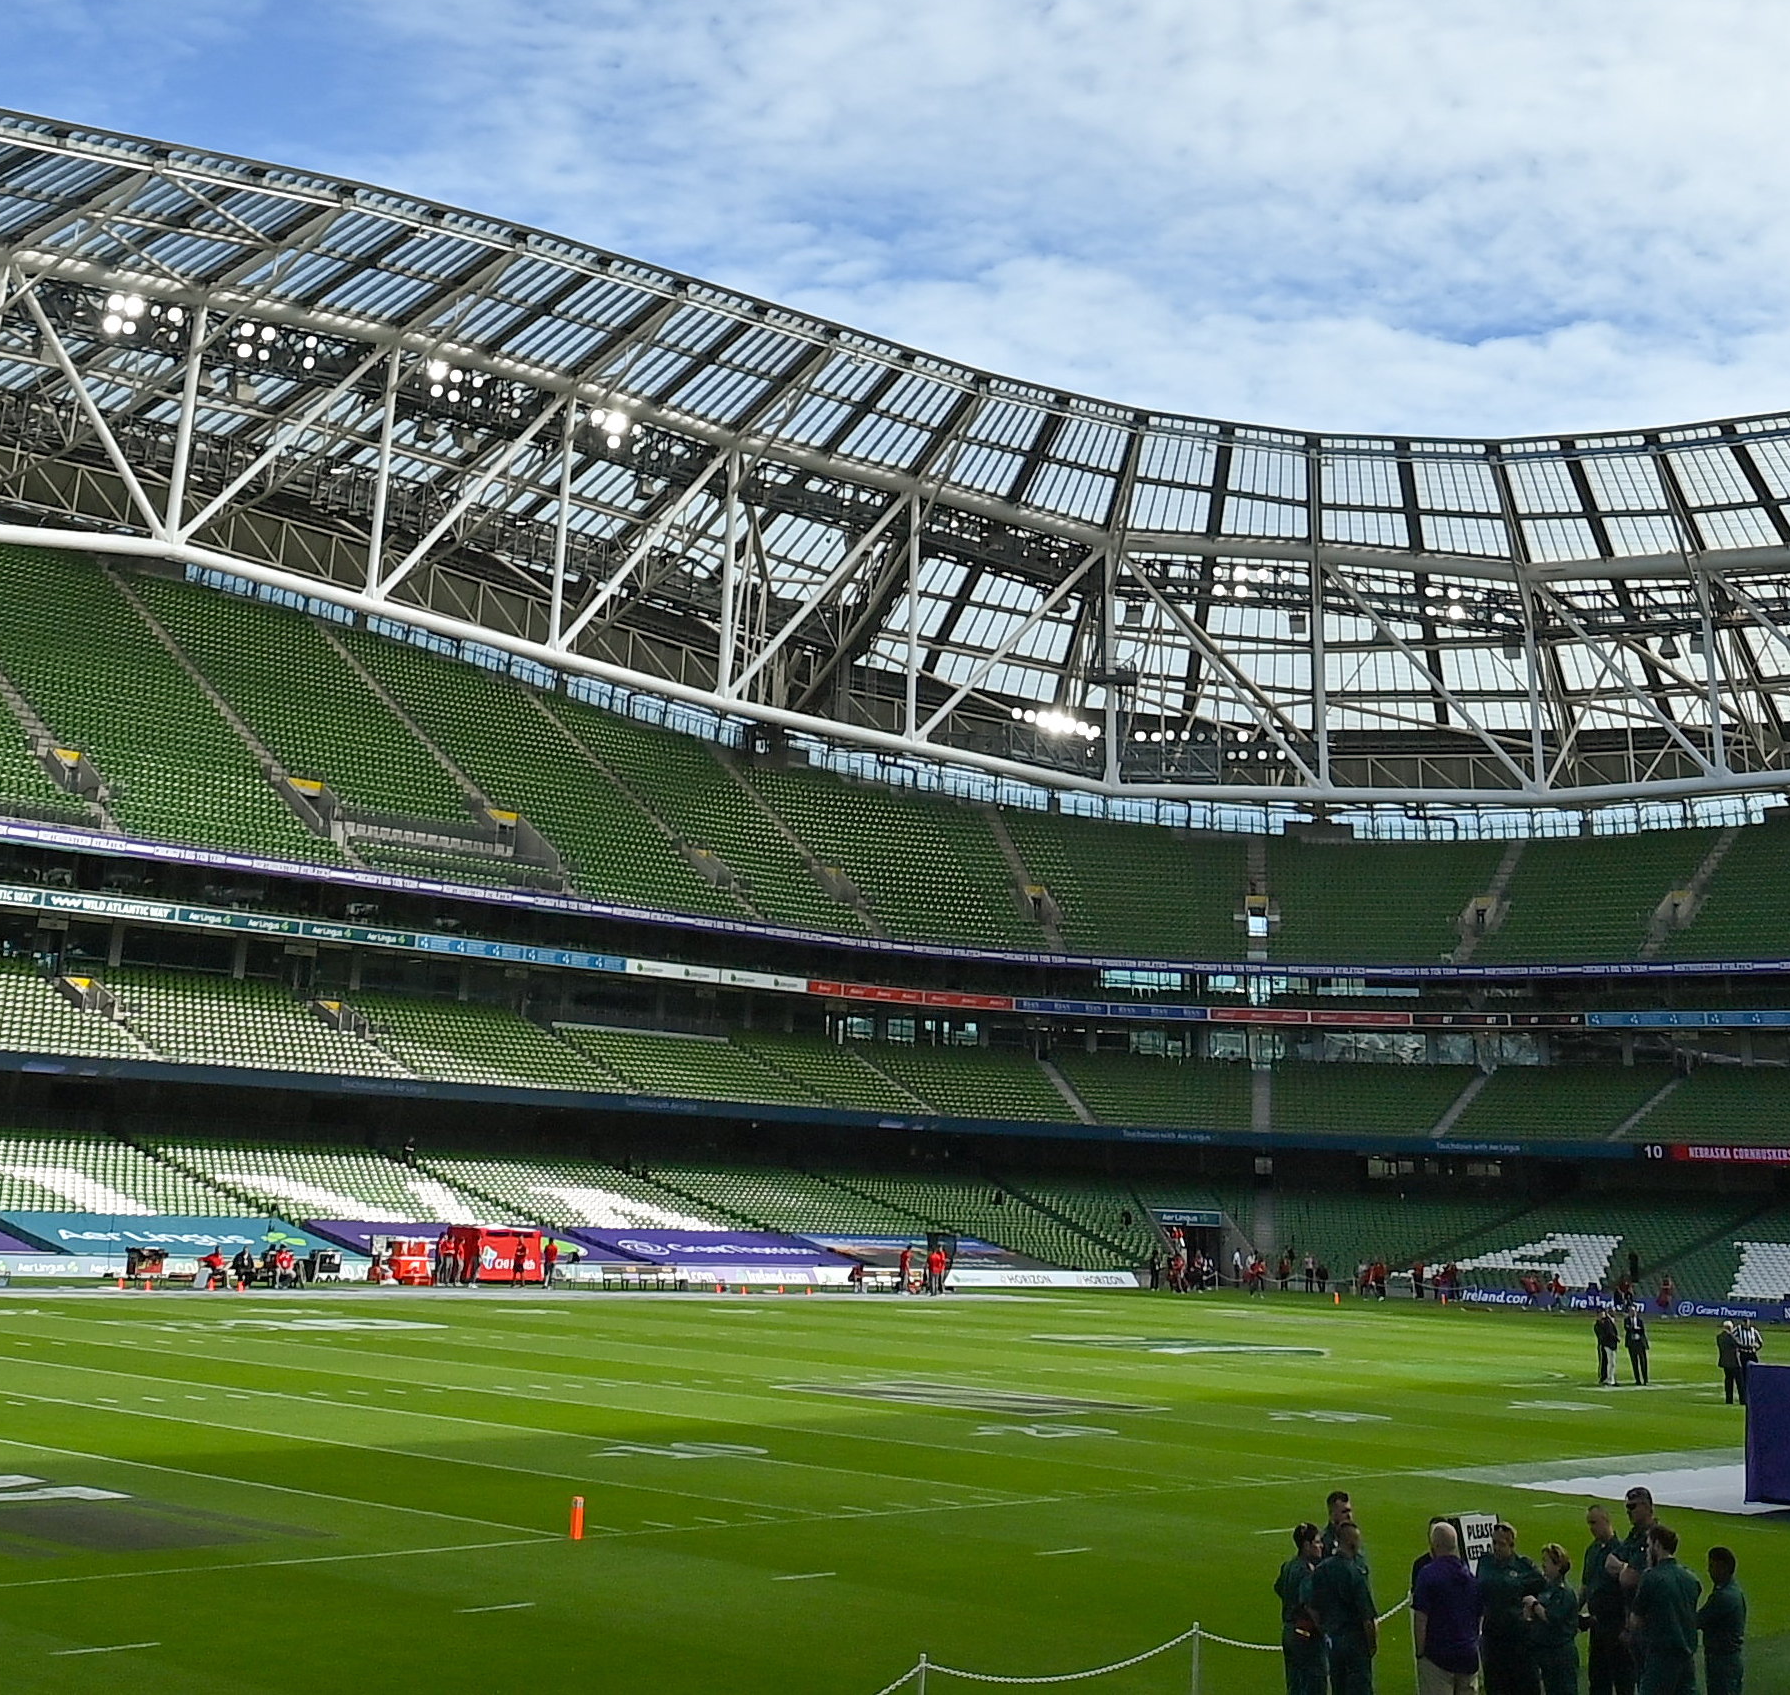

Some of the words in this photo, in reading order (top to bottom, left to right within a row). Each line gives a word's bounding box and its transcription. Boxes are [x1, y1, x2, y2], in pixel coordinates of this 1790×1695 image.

[14, 890, 36, 904] WAY
[82, 898, 106, 911] WILD
[106, 901, 149, 917] ATLANTIC
[150, 906, 171, 919] WAY
[1644, 1146, 1662, 1159] 10
[1688, 1147, 1731, 1160] NEBRASKA
[57, 1228, 121, 1241] Aer
[123, 1231, 255, 1246] Lingus
[1008, 1273, 1053, 1285] HORIZON
[1083, 1273, 1125, 1285] HORIZON
[1696, 1306, 1721, 1316] Grant
[1720, 1307, 1757, 1319] Thornton
[1467, 1523, 1493, 1540] PLEASE
